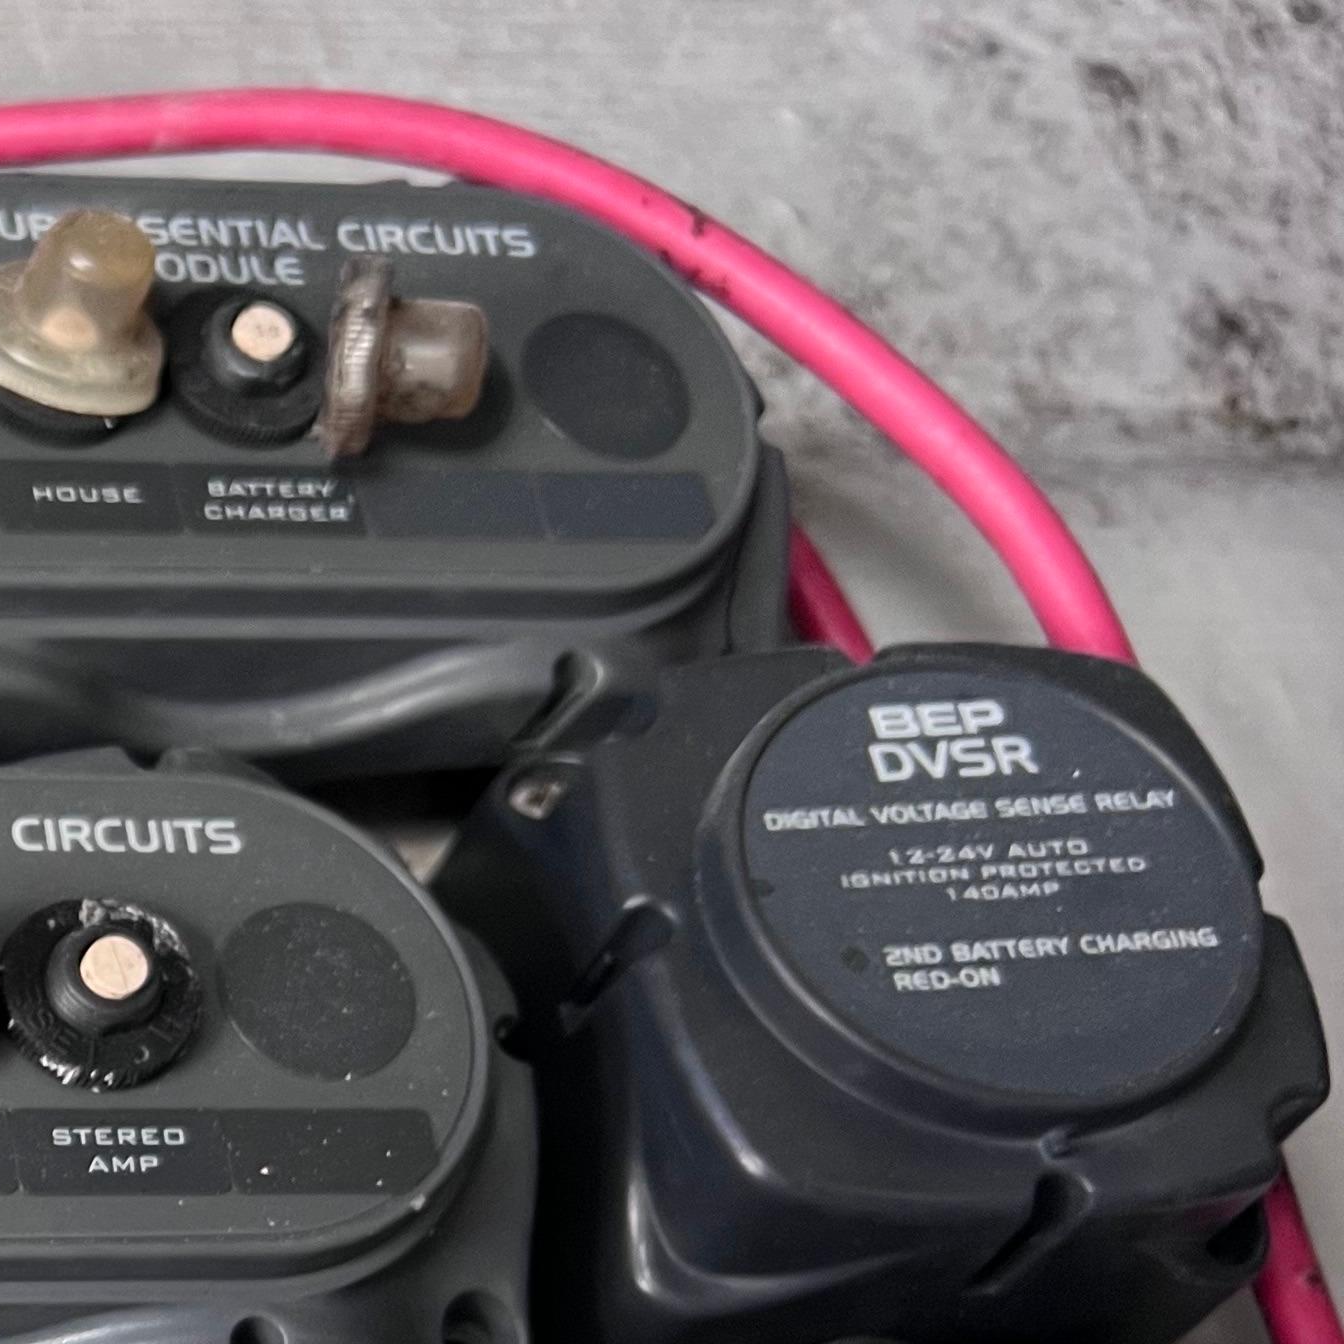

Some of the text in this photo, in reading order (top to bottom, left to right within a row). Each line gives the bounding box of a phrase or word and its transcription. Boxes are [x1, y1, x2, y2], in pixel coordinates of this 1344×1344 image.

[136, 215, 326, 252] SENTIAL
[338, 221, 535, 258] CIRCUITS
[154, 251, 305, 286] ODULE
[32, 486, 144, 504] HOUSE
[206, 477, 339, 498] BATTERY
[203, 502, 351, 522] CHARGER
[867, 699, 1006, 740] BEP
[867, 735, 1041, 783] DVSR
[763, 789, 1176, 832] DIGITAL VOLTAGE SENSE RELAY
[11, 816, 243, 855] CIRCUITS
[888, 838, 1091, 866] 12-24V AUTO
[840, 856, 1147, 891] IGNITION PROTECTED
[882, 926, 1221, 968] 2ND BATTERY CHARGING
[893, 967, 1001, 993] RED-ON
[52, 1126, 186, 1146] STEREO
[88, 1153, 159, 1173] AMP
